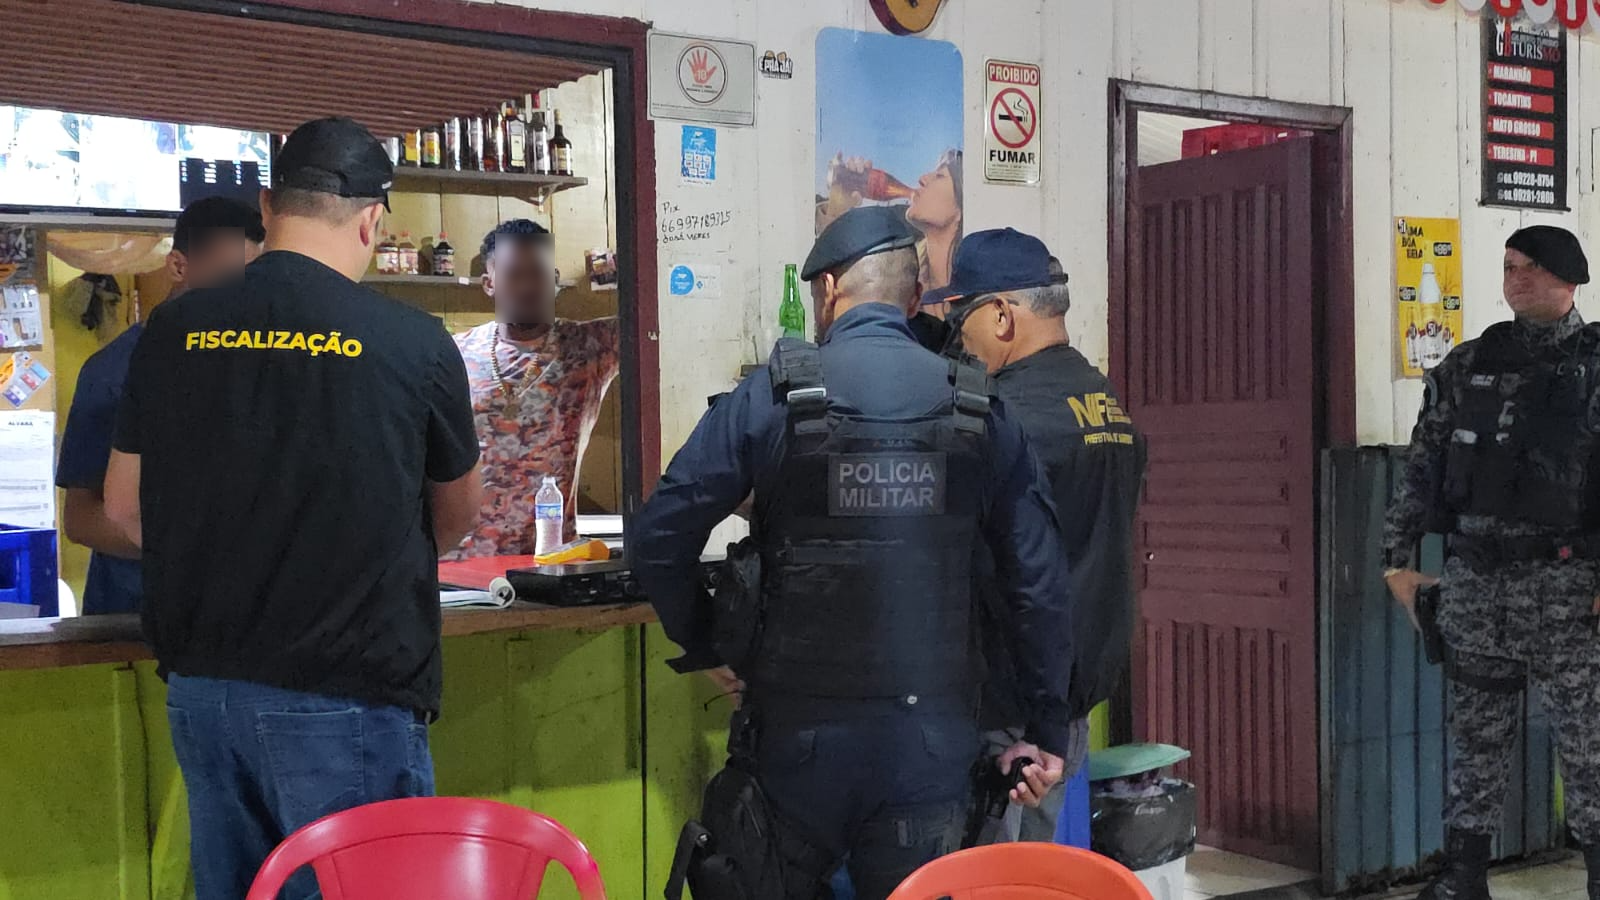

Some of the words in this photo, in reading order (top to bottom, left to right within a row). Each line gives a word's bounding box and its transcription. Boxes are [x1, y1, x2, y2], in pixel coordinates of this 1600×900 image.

[989, 64, 1038, 85] PROIBIDO
[1493, 64, 1532, 84] MARANHÃO
[1493, 91, 1532, 110] TOCANTINS
[1493, 118, 1513, 133] MATO
[1513, 120, 1541, 137] GROSSO
[989, 149, 1036, 164] FUMAR
[662, 201, 680, 214] Pix
[185, 330, 363, 358] FISCALIZAÇÃO
[840, 460, 935, 483] POLÍCIA
[840, 487, 934, 507] MILITAR
